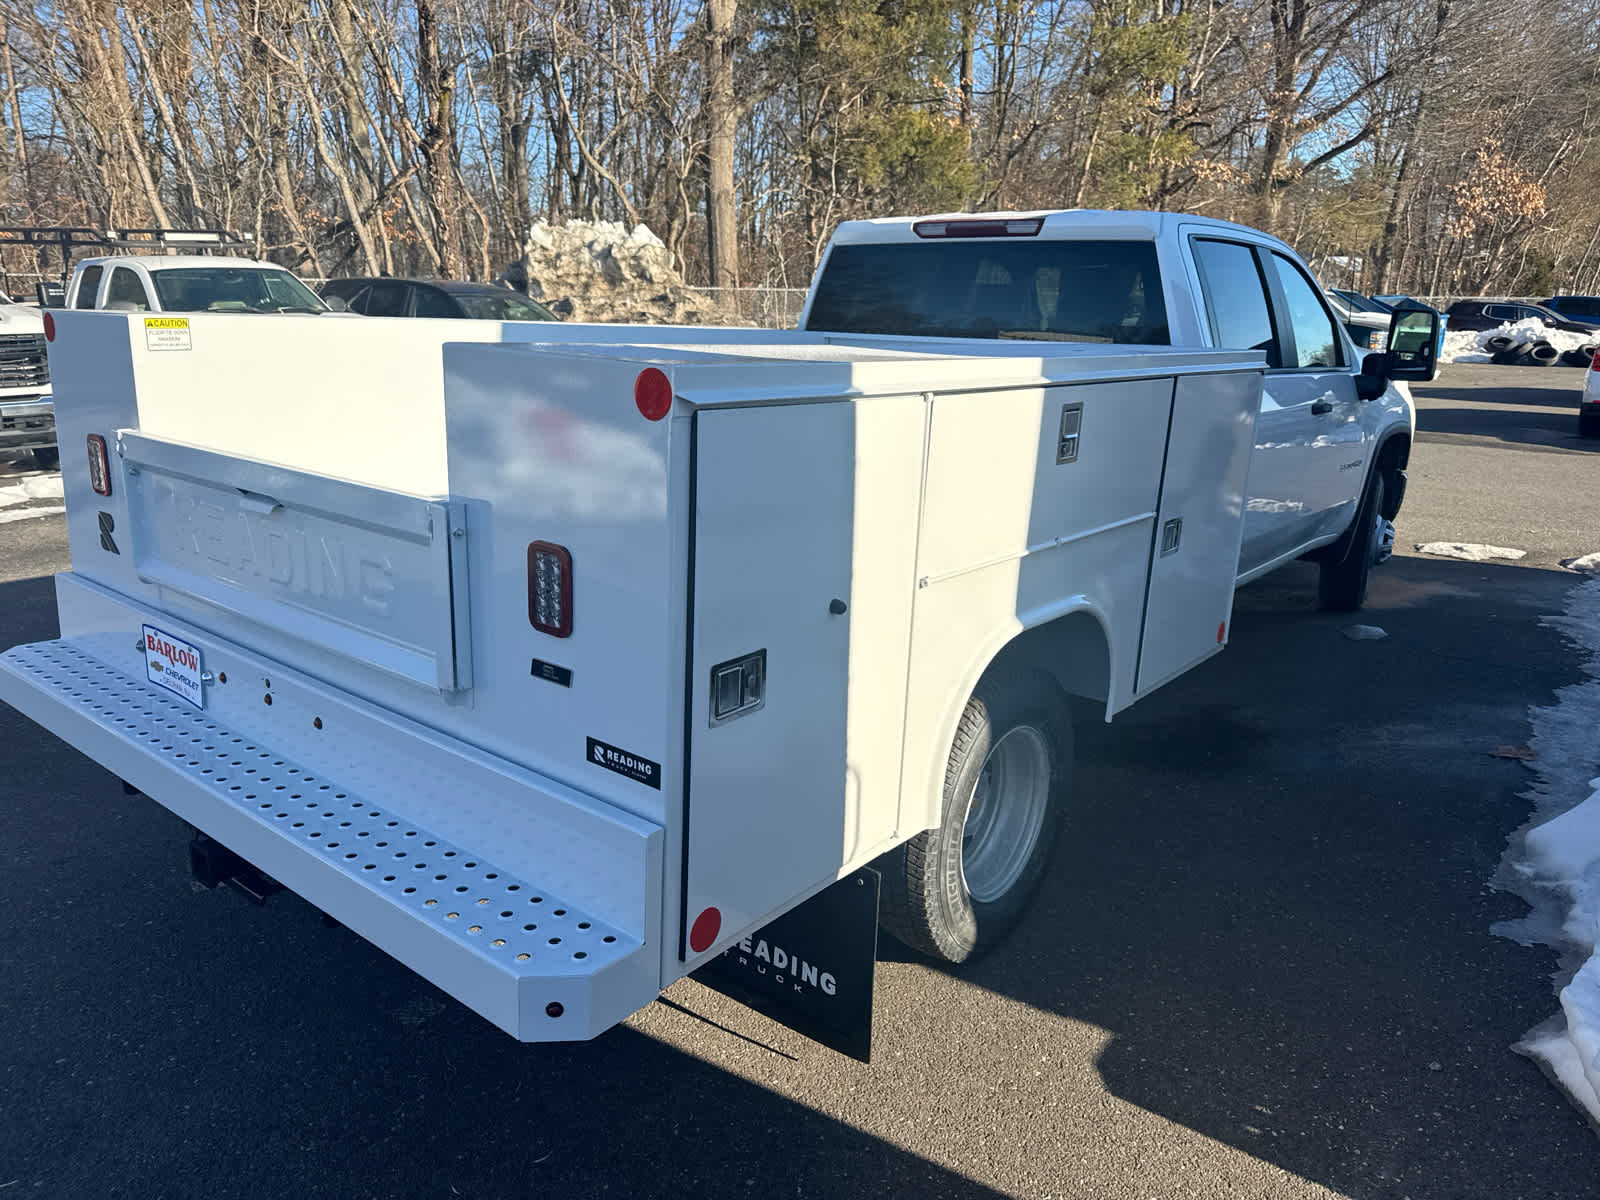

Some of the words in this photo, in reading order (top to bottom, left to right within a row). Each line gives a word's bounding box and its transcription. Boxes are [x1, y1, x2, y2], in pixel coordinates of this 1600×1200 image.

[153, 319, 188, 327] CAUTION
[146, 634, 198, 672] BARLOW
[165, 667, 199, 690] CHEVROLET
[607, 750, 652, 775] READING
[723, 950, 803, 993] TRUCK
[735, 934, 837, 996] EADING
